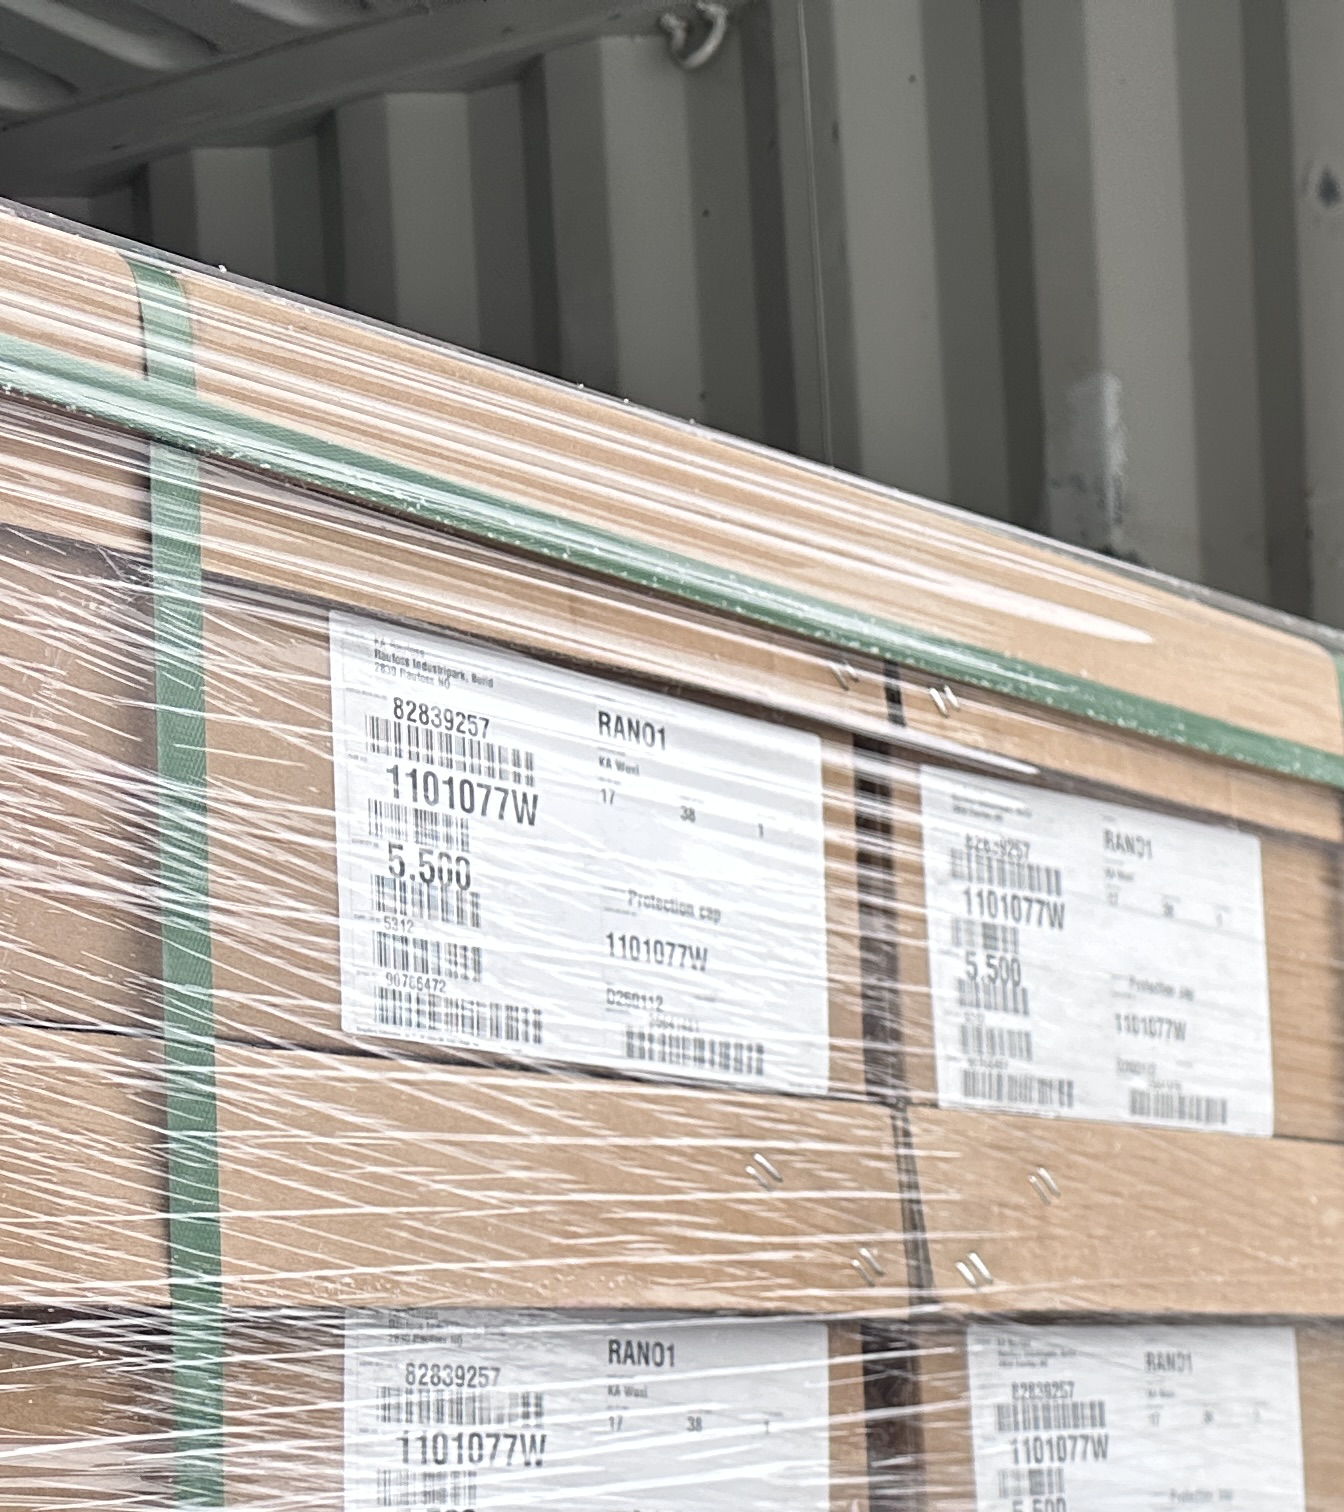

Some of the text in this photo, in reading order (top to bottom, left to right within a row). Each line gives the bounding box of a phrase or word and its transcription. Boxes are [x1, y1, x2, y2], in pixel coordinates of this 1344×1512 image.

[393, 697, 490, 739] 82839257
[386, 764, 538, 826] 1101077W
[388, 841, 471, 891] 5.500
[963, 886, 1065, 930] 1101077W
[606, 932, 708, 972] 1101077W
[405, 1363, 501, 1388] 82839257
[397, 1430, 547, 1467] 1101077W
[1009, 1434, 1109, 1464] 1101077W
